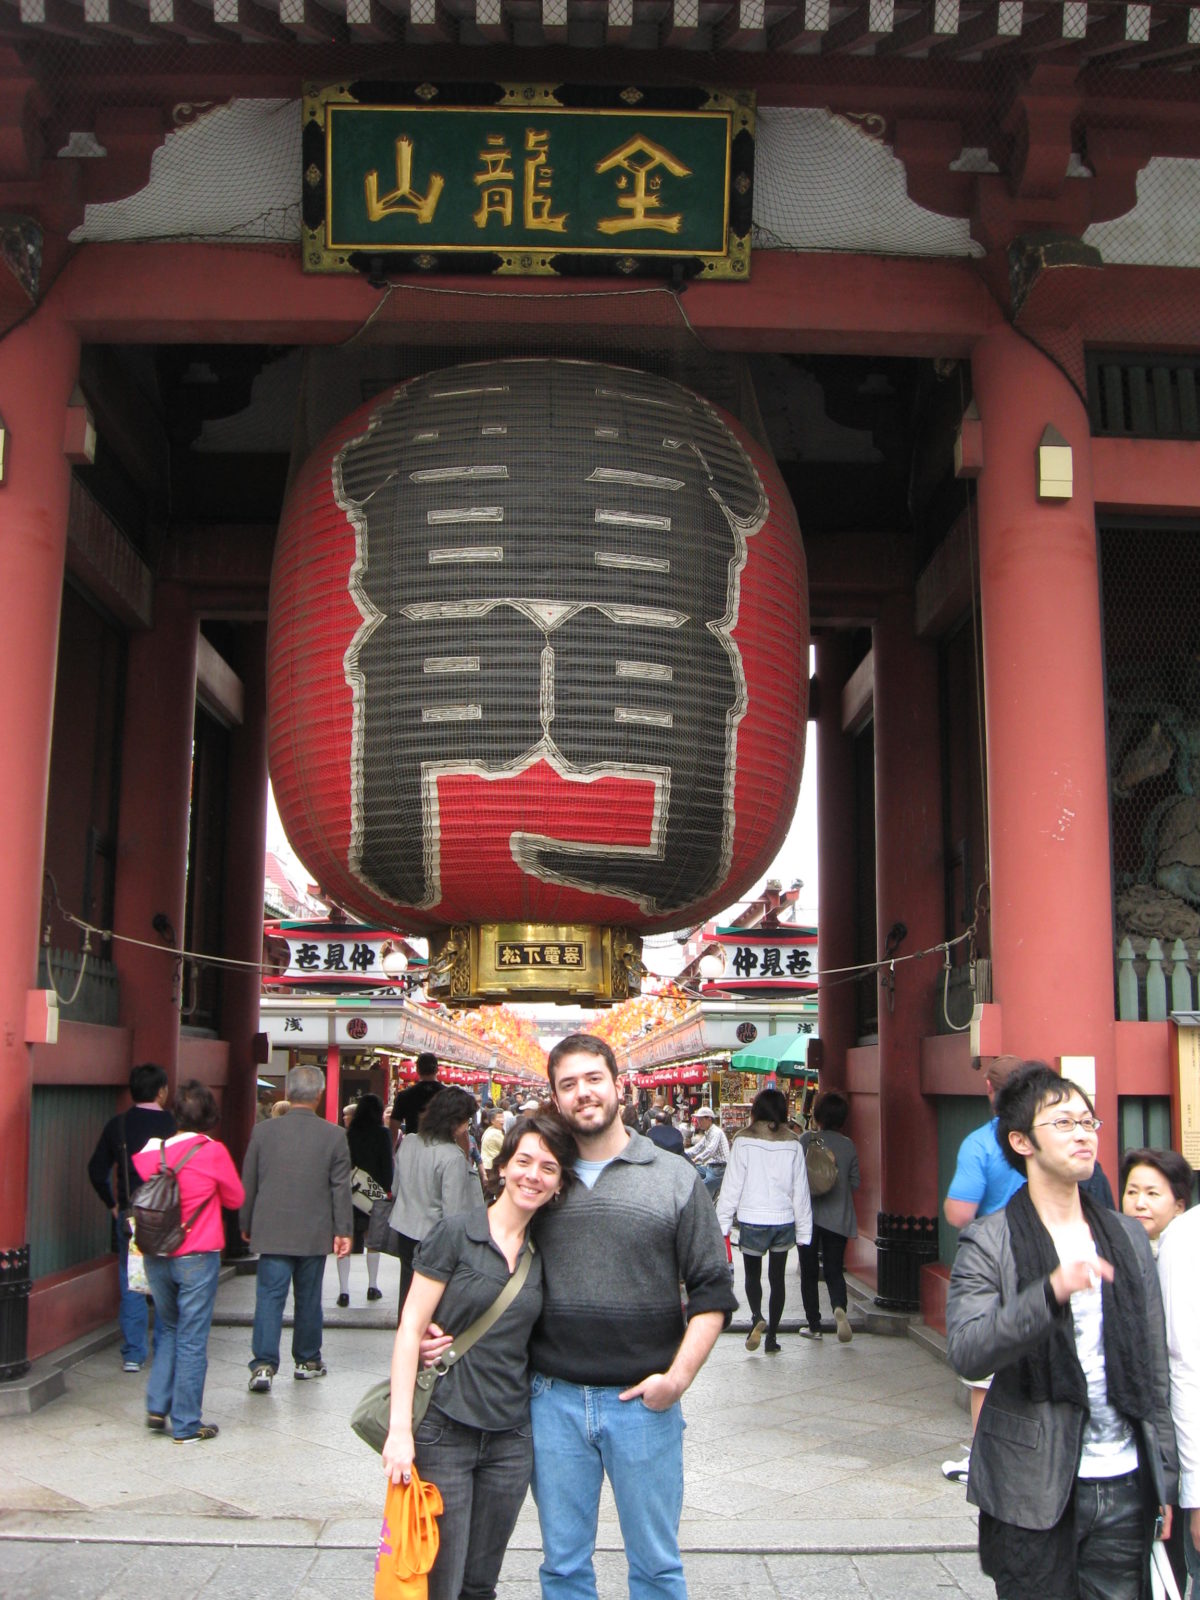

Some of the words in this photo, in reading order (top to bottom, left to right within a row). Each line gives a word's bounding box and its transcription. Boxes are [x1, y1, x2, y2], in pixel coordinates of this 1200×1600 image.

[501, 946, 581, 965] 松下電器
[733, 946, 812, 978] 仲見世
